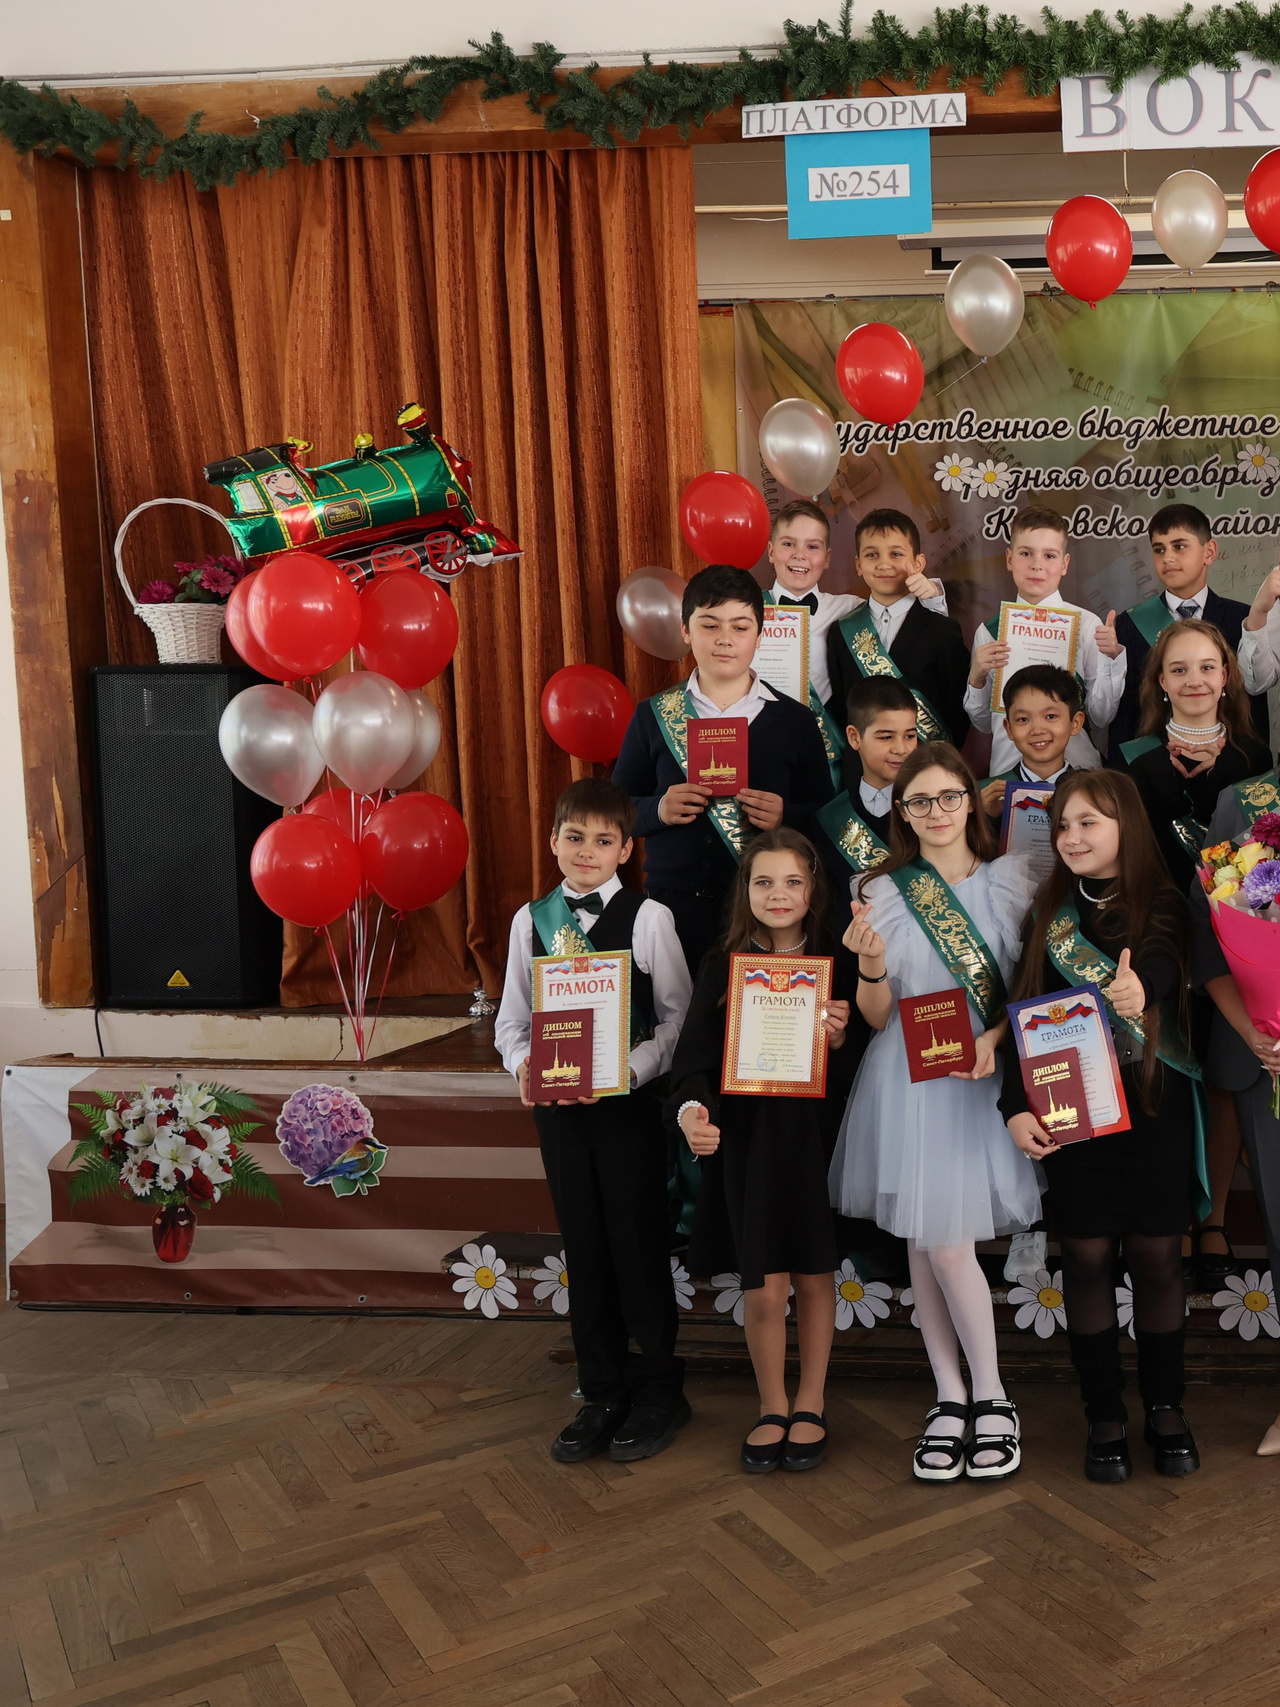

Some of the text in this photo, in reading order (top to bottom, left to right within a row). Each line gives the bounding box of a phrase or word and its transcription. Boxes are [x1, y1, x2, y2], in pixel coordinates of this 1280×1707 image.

[743, 98, 965, 137] ПЛАТФОРМА
[815, 169, 900, 199] №254
[836, 408, 1070, 454] ударственное
[1079, 406, 1278, 449] бюджетное
[963, 467, 1088, 500] дняя
[762, 627, 797, 638] МОТА
[1012, 625, 1066, 641] ГРАМОТА
[698, 728, 736, 737] ДИПЛОМ
[548, 978, 616, 997] ГРАМОТА
[752, 995, 806, 1007] ГРАМОТА
[914, 1000, 955, 1016] ДИПЛОМ
[542, 1021, 582, 1033] ДИПЛОМ
[1041, 1023, 1086, 1042] ГРАМОТА
[1032, 1061, 1069, 1079] ДИПЛОМ
[541, 1080, 580, 1088] Санкт-Петербург
